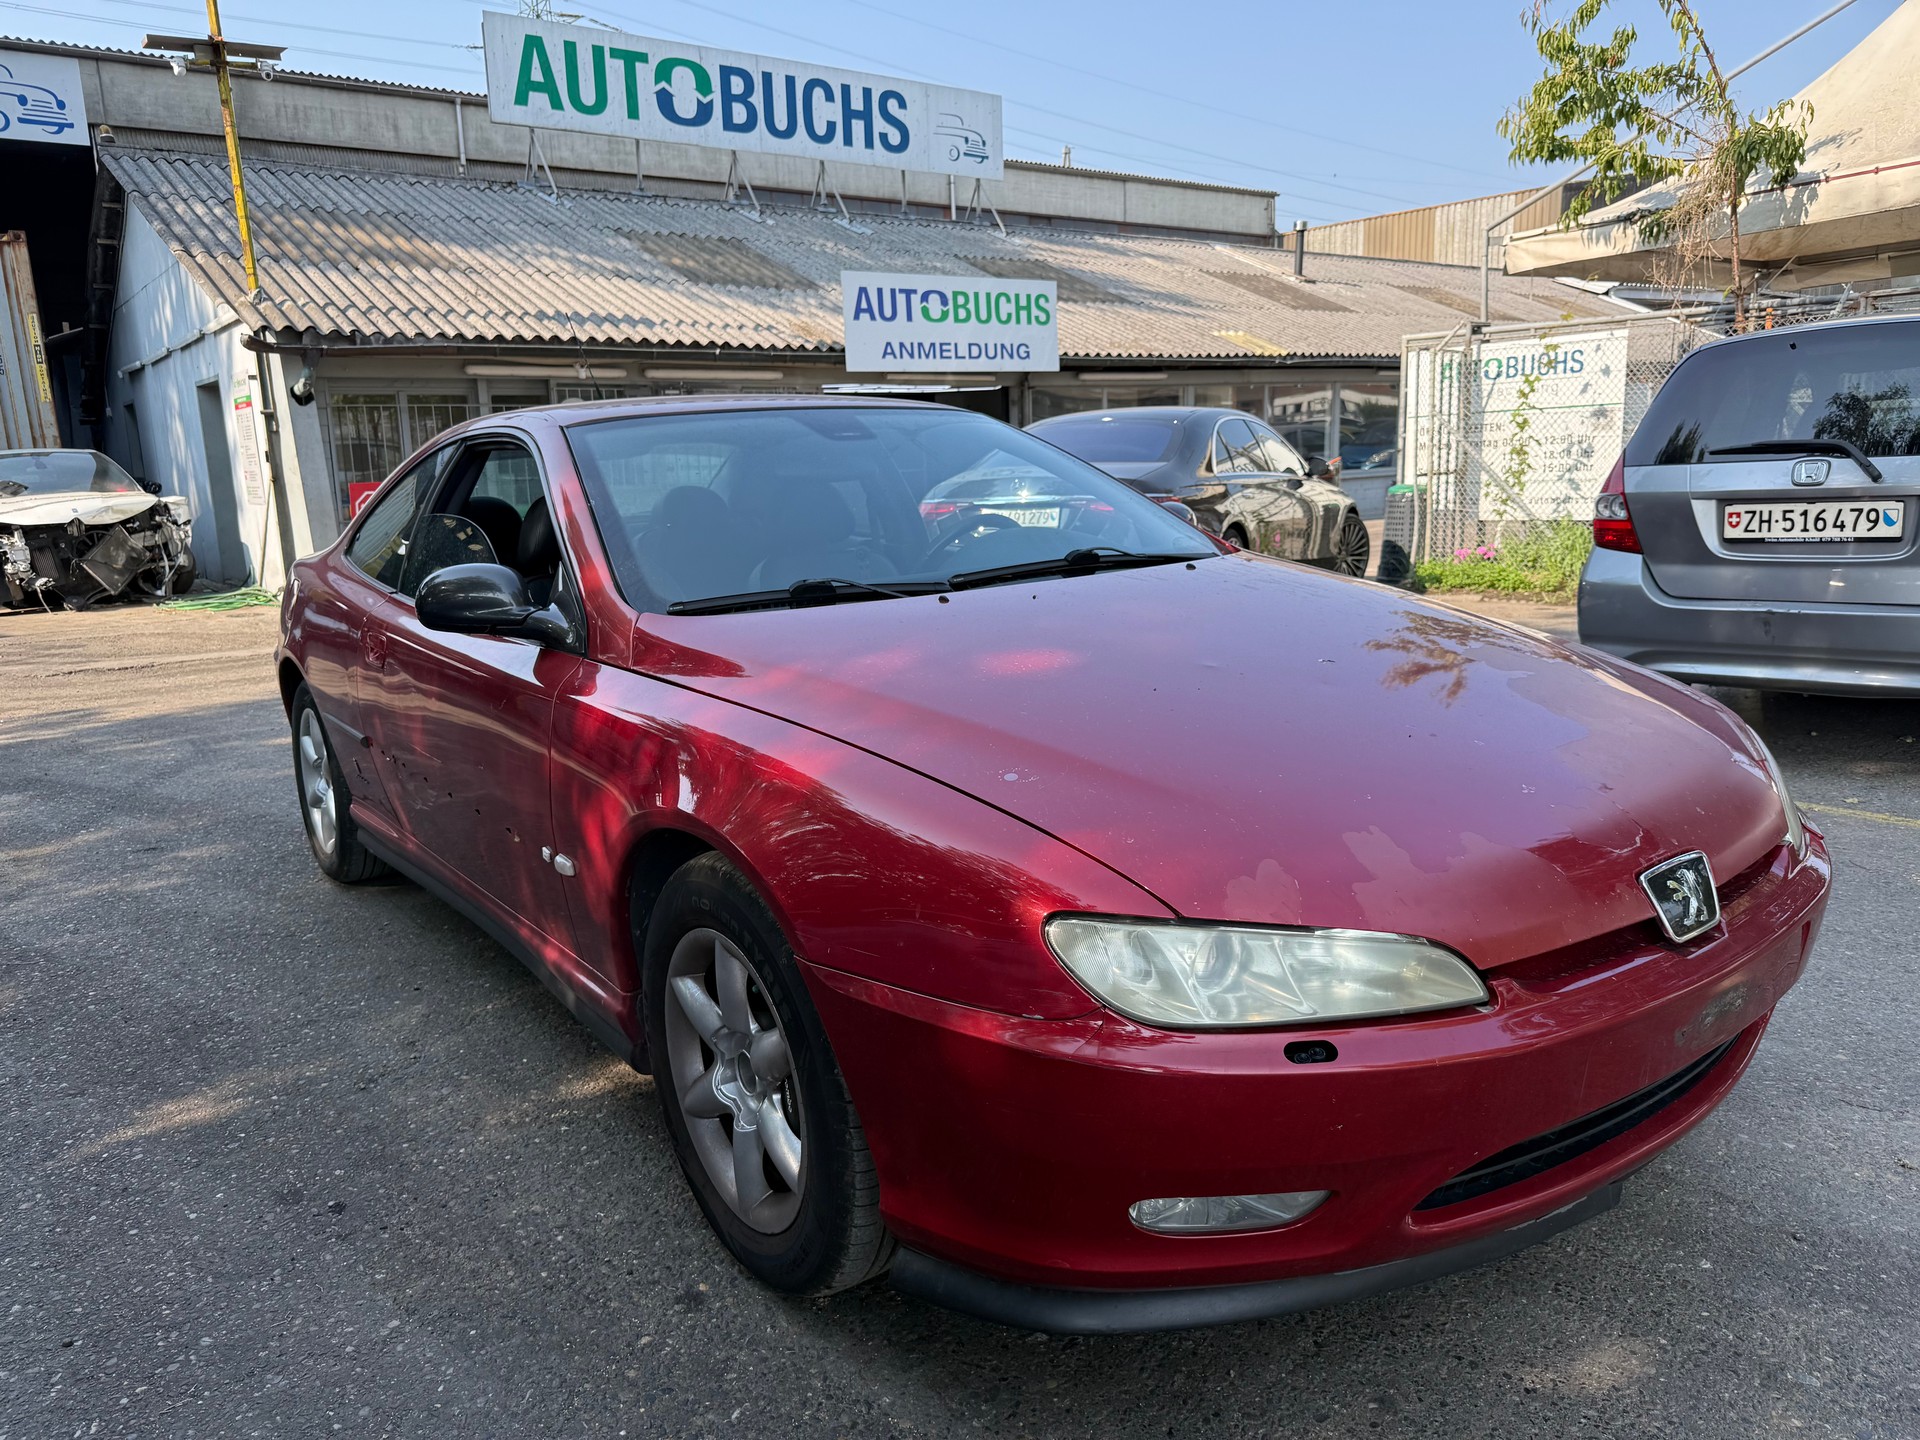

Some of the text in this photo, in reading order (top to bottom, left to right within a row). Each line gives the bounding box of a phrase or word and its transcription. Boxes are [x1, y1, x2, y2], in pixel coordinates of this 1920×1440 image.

[514, 34, 910, 154] AUTOBUCHS
[853, 286, 1051, 326] AUTOBUCHS
[882, 341, 1031, 361] ANMELDUNG
